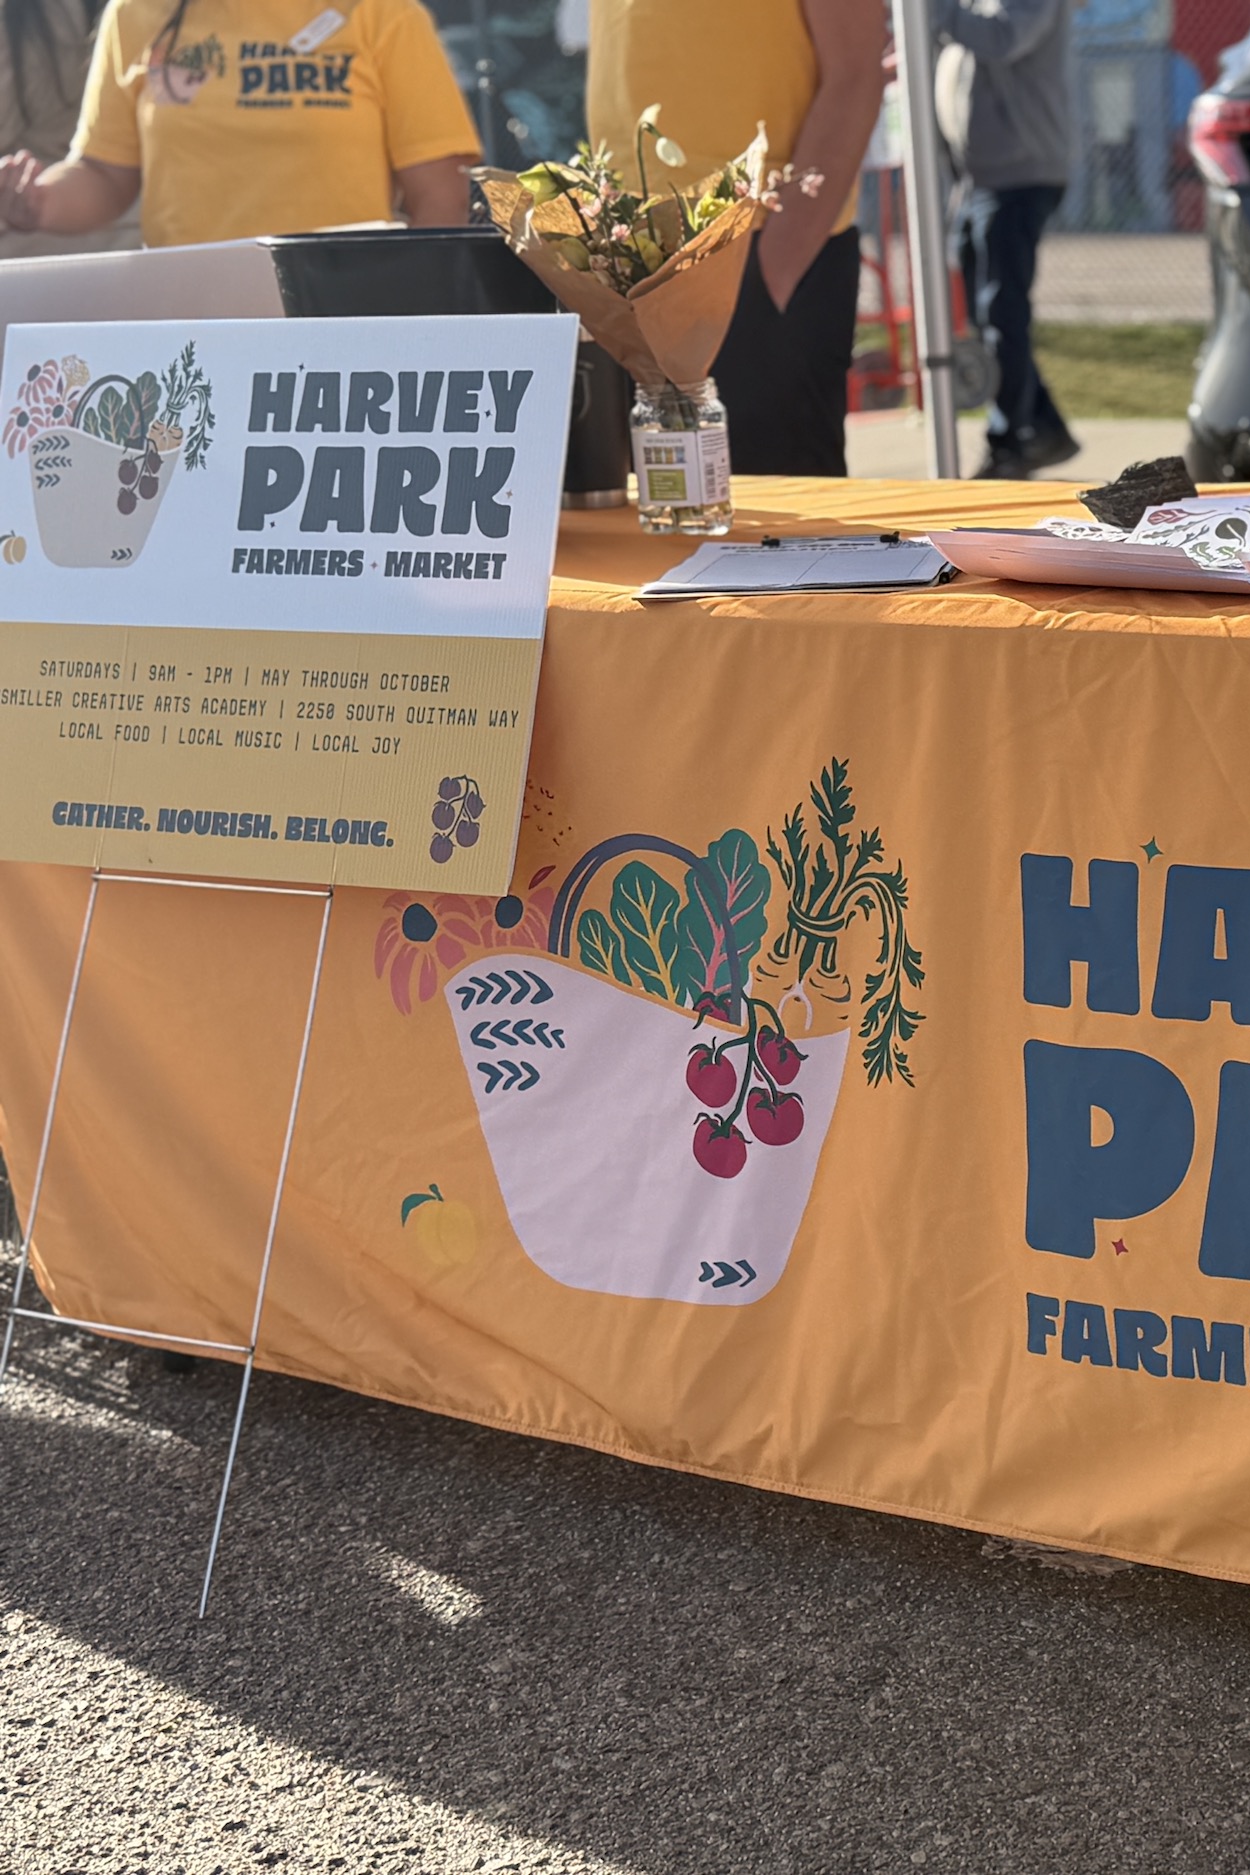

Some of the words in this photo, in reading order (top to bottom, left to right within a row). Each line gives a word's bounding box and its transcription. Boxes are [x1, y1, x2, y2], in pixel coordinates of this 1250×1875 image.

[241, 63, 351, 95] PARK
[247, 370, 534, 434] HARVEY
[237, 446, 515, 538] PARK
[231, 549, 364, 577] FARMERS
[384, 551, 507, 580] MARKET
[40, 660, 121, 680] SATURDAYS
[149, 665, 176, 682] 9AM
[204, 667, 232, 684] 1PM
[261, 669, 290, 686] MAY
[302, 670, 369, 690] THROUGH
[380, 673, 450, 693] OCTOBER
[72, 692, 144, 712] CREATIVE
[154, 695, 191, 714] ARTS
[201, 697, 267, 716] ACADEMY
[297, 702, 335, 720] 2250
[346, 703, 395, 722] SOUTH
[406, 706, 477, 727] QUITMAN
[489, 709, 519, 728] WAY
[59, 721, 103, 740] LOCAL
[114, 724, 150, 742] FOOD
[179, 727, 224, 747] LOCAL
[235, 730, 282, 749] MUSIC
[312, 734, 359, 753] LOCAL
[372, 737, 401, 755] JOY
[52, 801, 151, 832] GATHER.
[157, 808, 278, 840] NOURISH.
[285, 816, 394, 848] BELONG.
